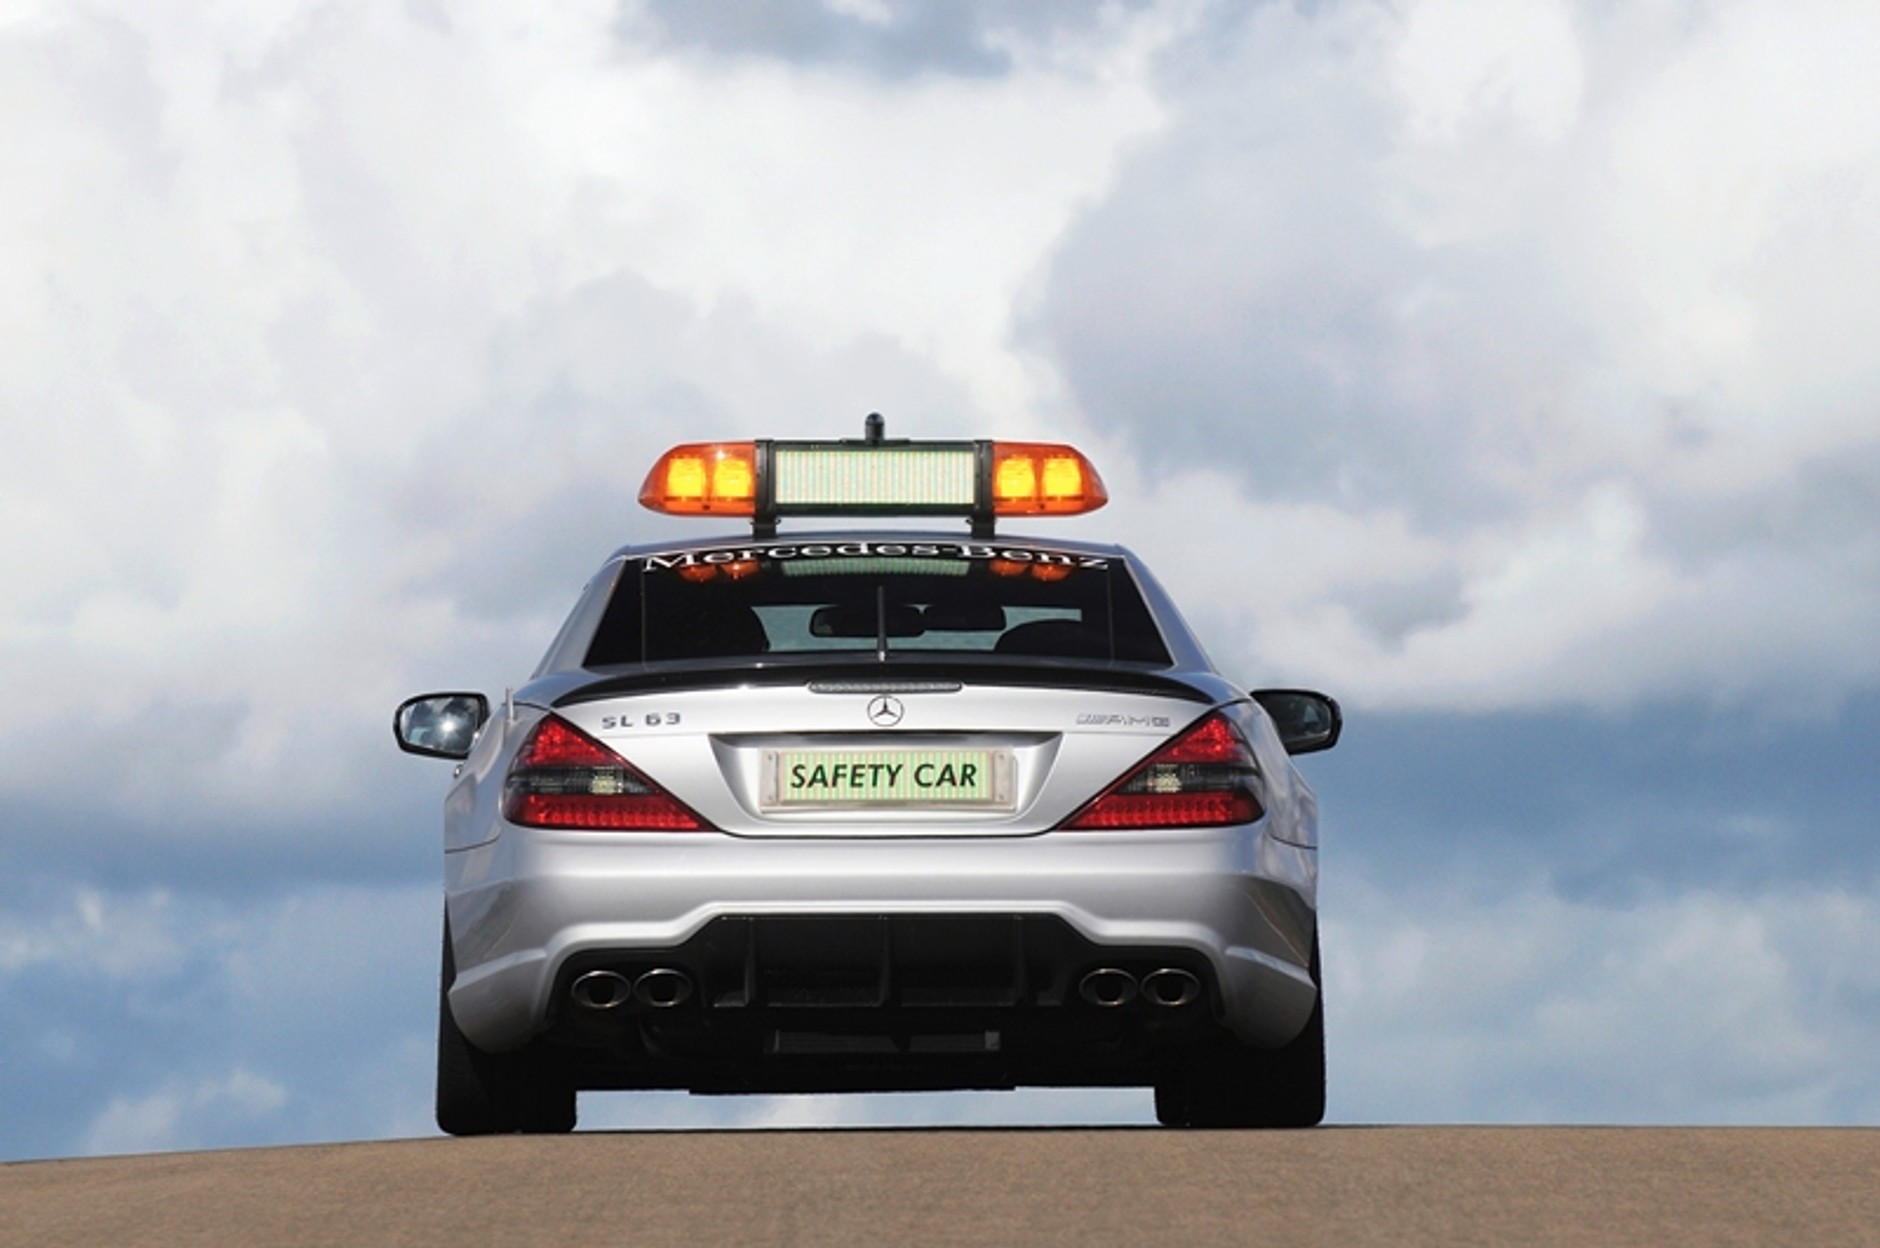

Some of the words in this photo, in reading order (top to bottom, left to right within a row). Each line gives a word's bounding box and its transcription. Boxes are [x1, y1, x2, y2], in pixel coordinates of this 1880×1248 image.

[642, 543, 1109, 572] Mercedes-Benz
[601, 715, 634, 730] SL
[645, 712, 681, 727] 63
[1106, 714, 1170, 728] AMG
[790, 763, 903, 788] SAFETY
[914, 763, 978, 788] CAR
